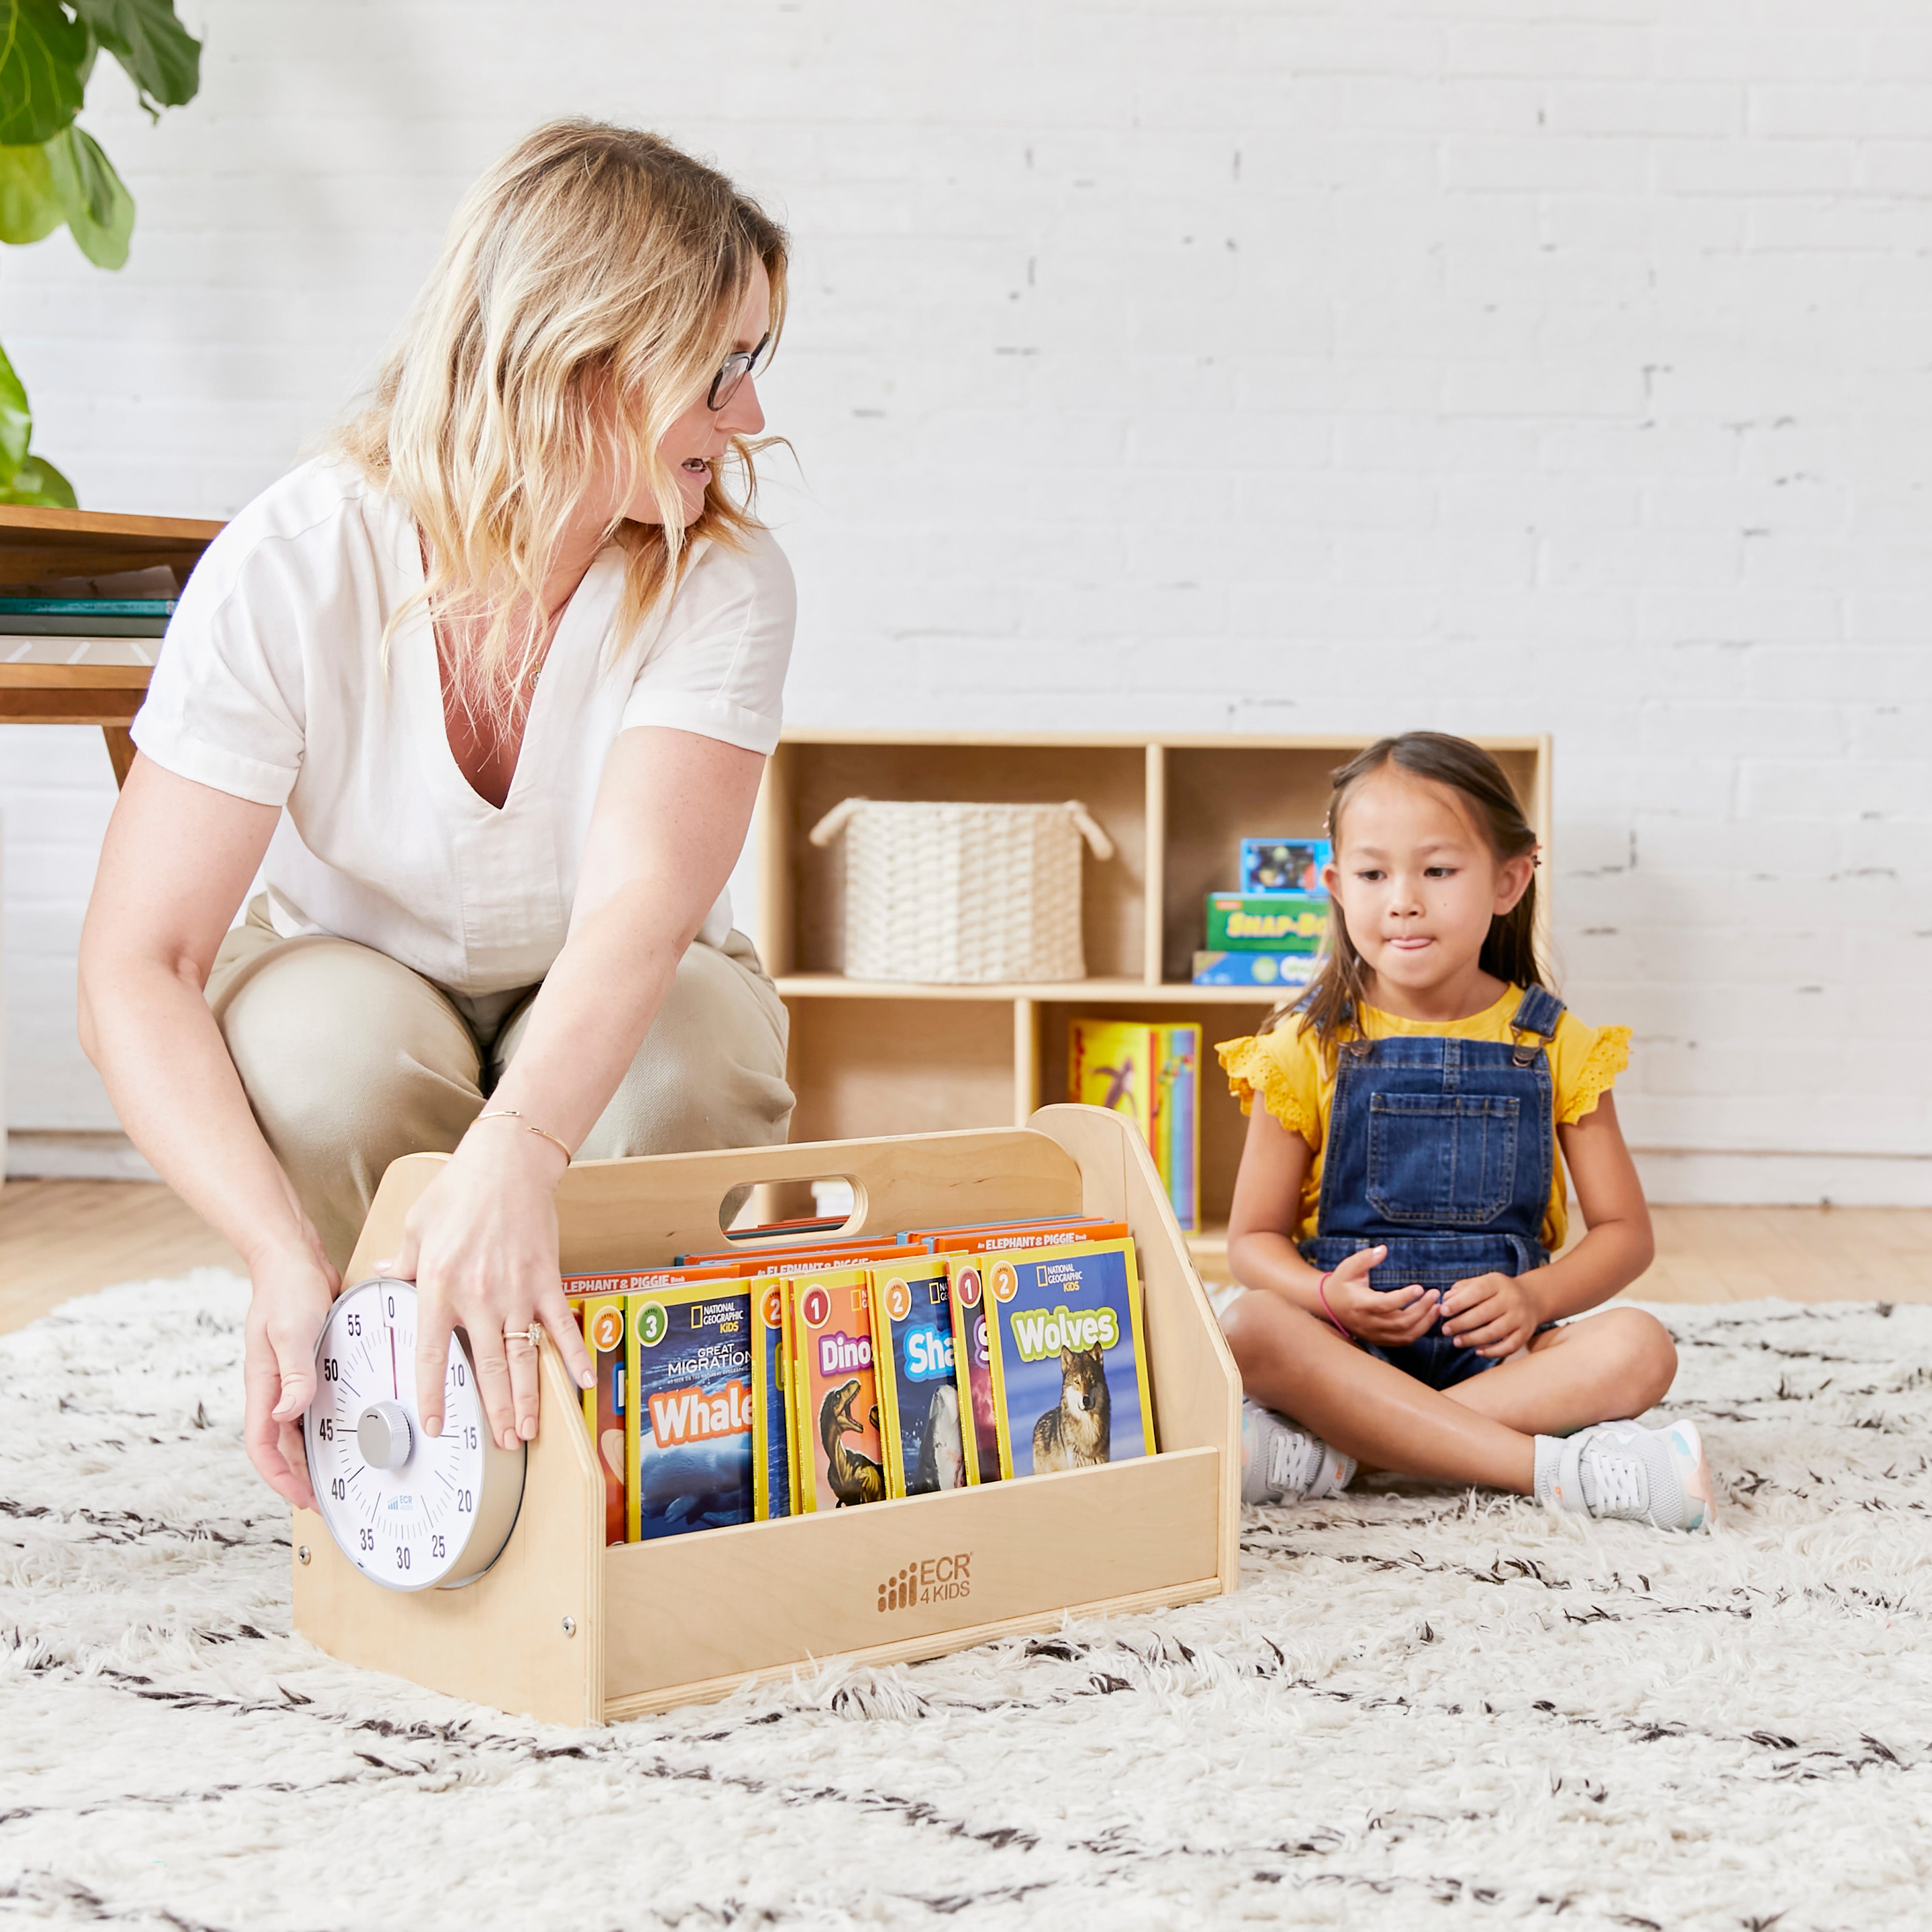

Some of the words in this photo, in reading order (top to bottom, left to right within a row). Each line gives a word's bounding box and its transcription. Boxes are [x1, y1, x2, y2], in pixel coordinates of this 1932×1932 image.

[986, 1236, 1035, 1250] ELEPHANT
[1036, 1236, 1042, 1246] &
[1044, 1233, 1075, 1245] PIGGIE
[1047, 1263, 1075, 1275] NATIONAL
[1048, 1271, 1082, 1284] GEOGRAPHIC
[562, 1279, 619, 1293] LEPHANT
[619, 1279, 628, 1289] &
[630, 1274, 670, 1288] PIGGIE
[965, 1279, 972, 1300] 1
[999, 1274, 1009, 1294] 2
[388, 1296, 395, 1319] 0
[704, 1302, 735, 1315] NATIONAL
[770, 1298, 781, 1321] 2
[811, 1298, 820, 1320] 1
[893, 1291, 903, 1313] 2
[348, 1314, 361, 1337] 55
[646, 1315, 657, 1338] 3
[703, 1310, 743, 1325] GEOGRAPHIC
[602, 1320, 613, 1343] 2
[1016, 1313, 1112, 1354] Wolves
[698, 1343, 735, 1358] GREAT
[822, 1336, 872, 1371] Dino
[324, 1358, 338, 1382] 50
[451, 1364, 465, 1387] 10
[320, 1418, 334, 1441] 45
[463, 1426, 477, 1449] 15
[331, 1477, 345, 1501] 40
[400, 1495, 412, 1504] ECR
[457, 1490, 472, 1512] 20
[360, 1528, 374, 1551] 35
[432, 1535, 445, 1559] 25
[397, 1547, 410, 1569] 30
[921, 1553, 970, 1586] ECR
